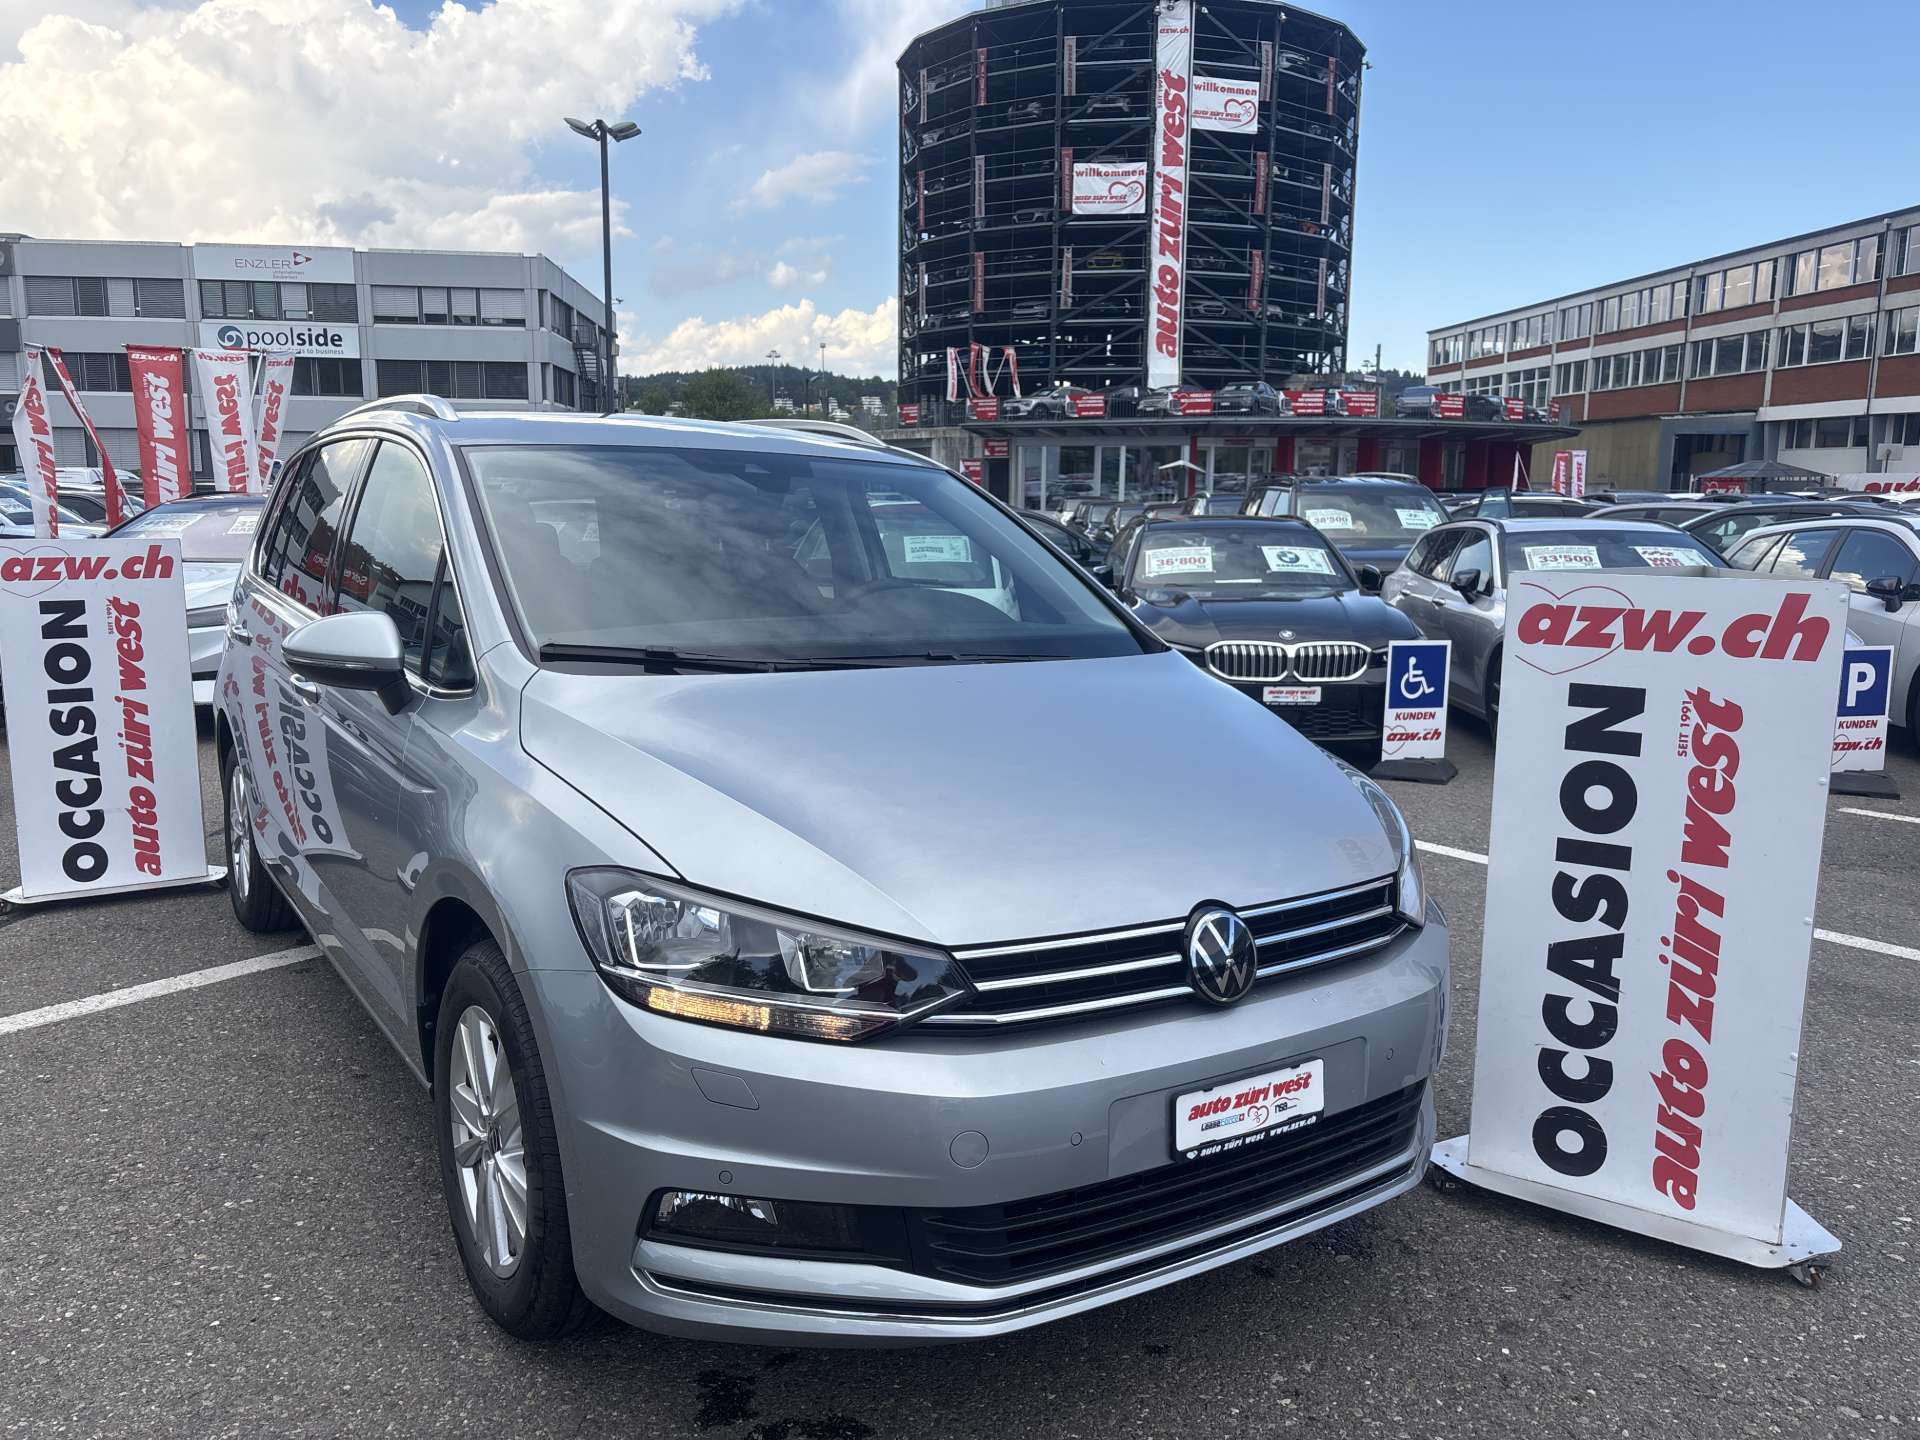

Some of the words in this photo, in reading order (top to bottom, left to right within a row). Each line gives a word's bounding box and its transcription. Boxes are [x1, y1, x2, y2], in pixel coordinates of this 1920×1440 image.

[1160, 26, 1189, 34] azw.ch
[1194, 82, 1257, 96] willkommen
[1160, 69, 1186, 167] west
[1075, 168, 1145, 178] willkommen
[1154, 171, 1183, 264] züri
[235, 258, 292, 269] ENZLER
[1152, 264, 1179, 358] auto
[247, 327, 343, 349] poolside
[316, 347, 344, 355] business
[131, 353, 178, 362] azw.ch
[145, 372, 175, 439] west
[261, 380, 284, 442] west
[1, 544, 174, 581] azw.ch
[1156, 556, 1206, 566] 36'800
[1538, 555, 1593, 563] 33'500
[106, 596, 147, 691] west
[1518, 593, 1830, 662] azw.ch
[1846, 662, 1876, 707] P
[1394, 711, 1436, 721] KUNDEN
[1680, 700, 1692, 727] 1991
[1838, 720, 1878, 729] KUNDEN
[39, 600, 109, 883] OCCASION
[114, 695, 155, 785] züri
[1386, 727, 1442, 742] azw.ch
[1677, 733, 1688, 758] SEIT
[1681, 687, 1744, 868] west
[126, 785, 162, 877] auto
[1531, 682, 1647, 1177] OCCASION
[1658, 869, 1726, 1046] züri
[1188, 1096, 1231, 1122] auto
[1232, 1082, 1271, 1109] züri
[1273, 1073, 1312, 1098] west
[1274, 1102, 1288, 1114] nsa
[1649, 1038, 1709, 1211] auto
[1200, 1145, 1221, 1157] auto
[1223, 1138, 1242, 1151] züri
[1245, 1131, 1265, 1144] west
